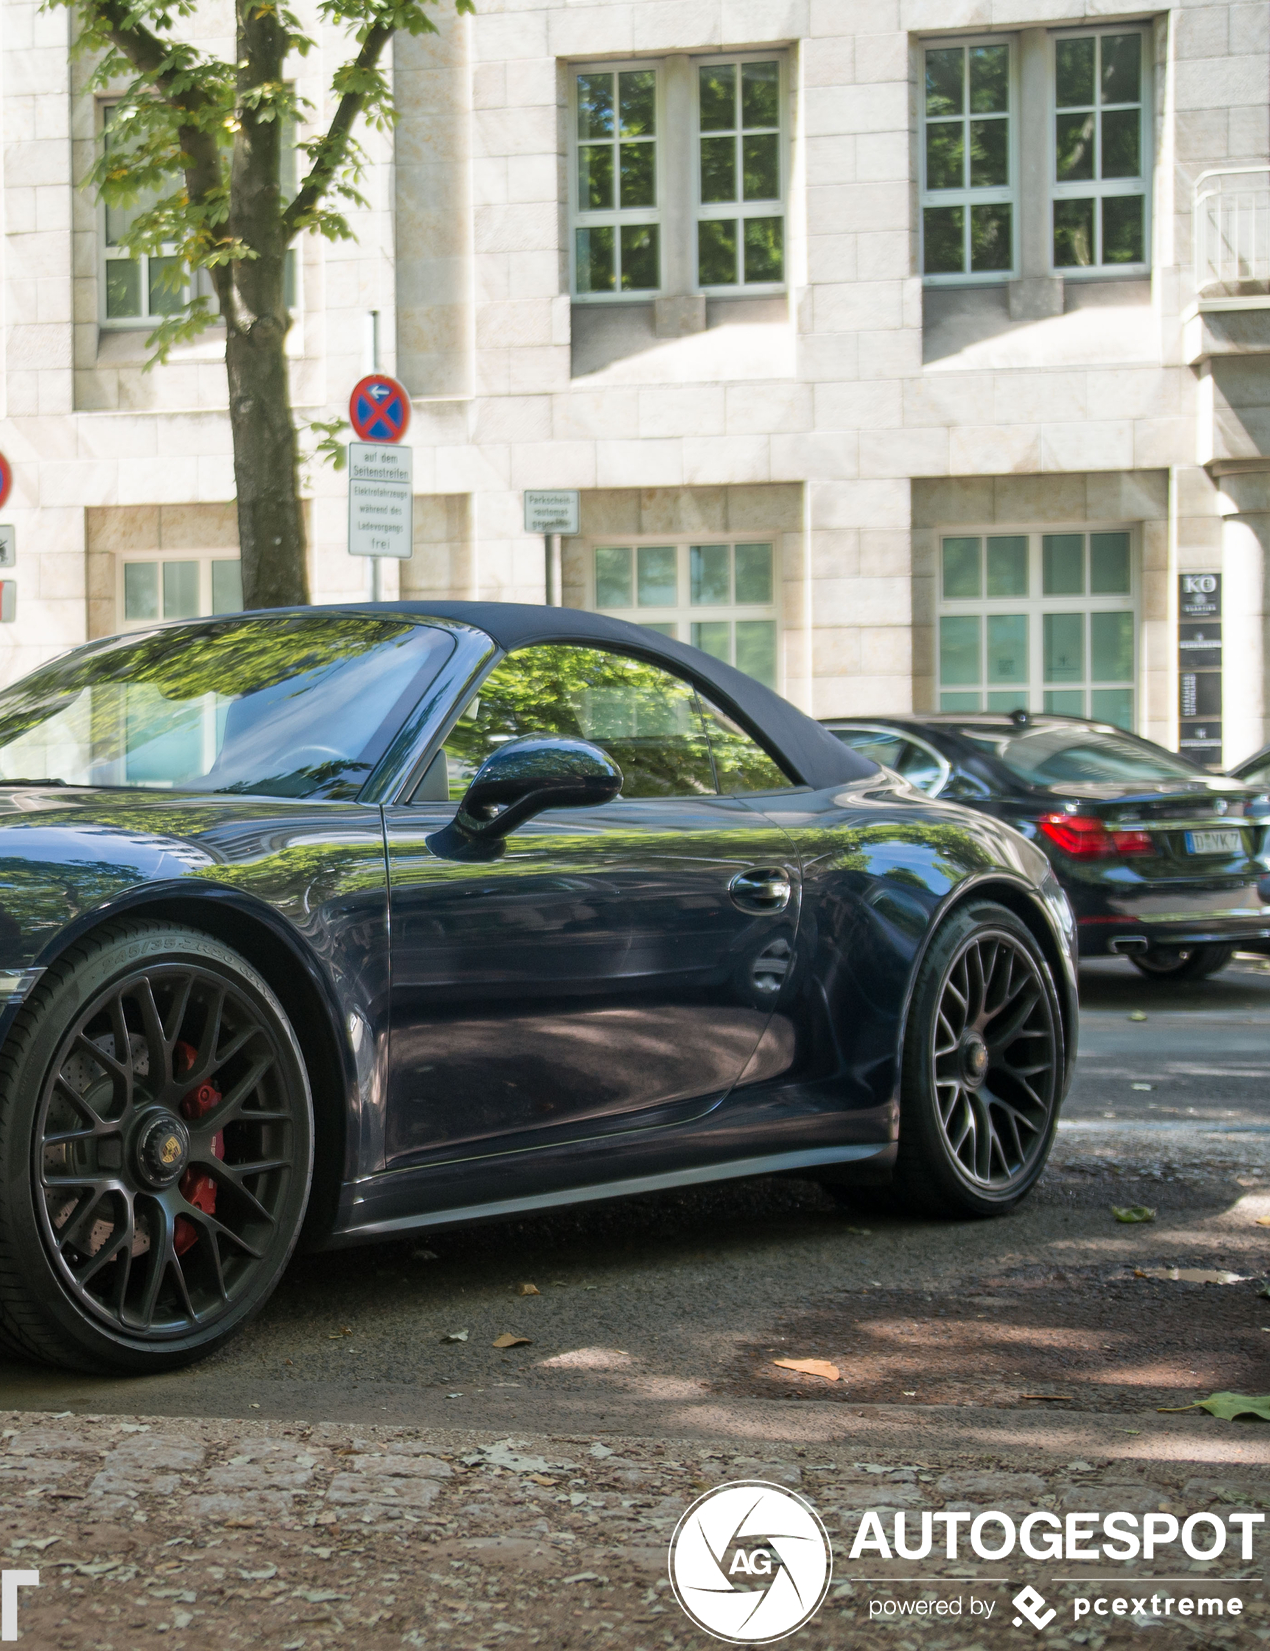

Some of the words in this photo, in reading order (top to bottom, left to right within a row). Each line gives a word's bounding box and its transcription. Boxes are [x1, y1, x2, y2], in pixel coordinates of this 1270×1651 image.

[364, 452, 377, 463] auf
[381, 452, 398, 464] dem
[353, 465, 409, 479] Seitenstreifen
[371, 538, 391, 550] frei
